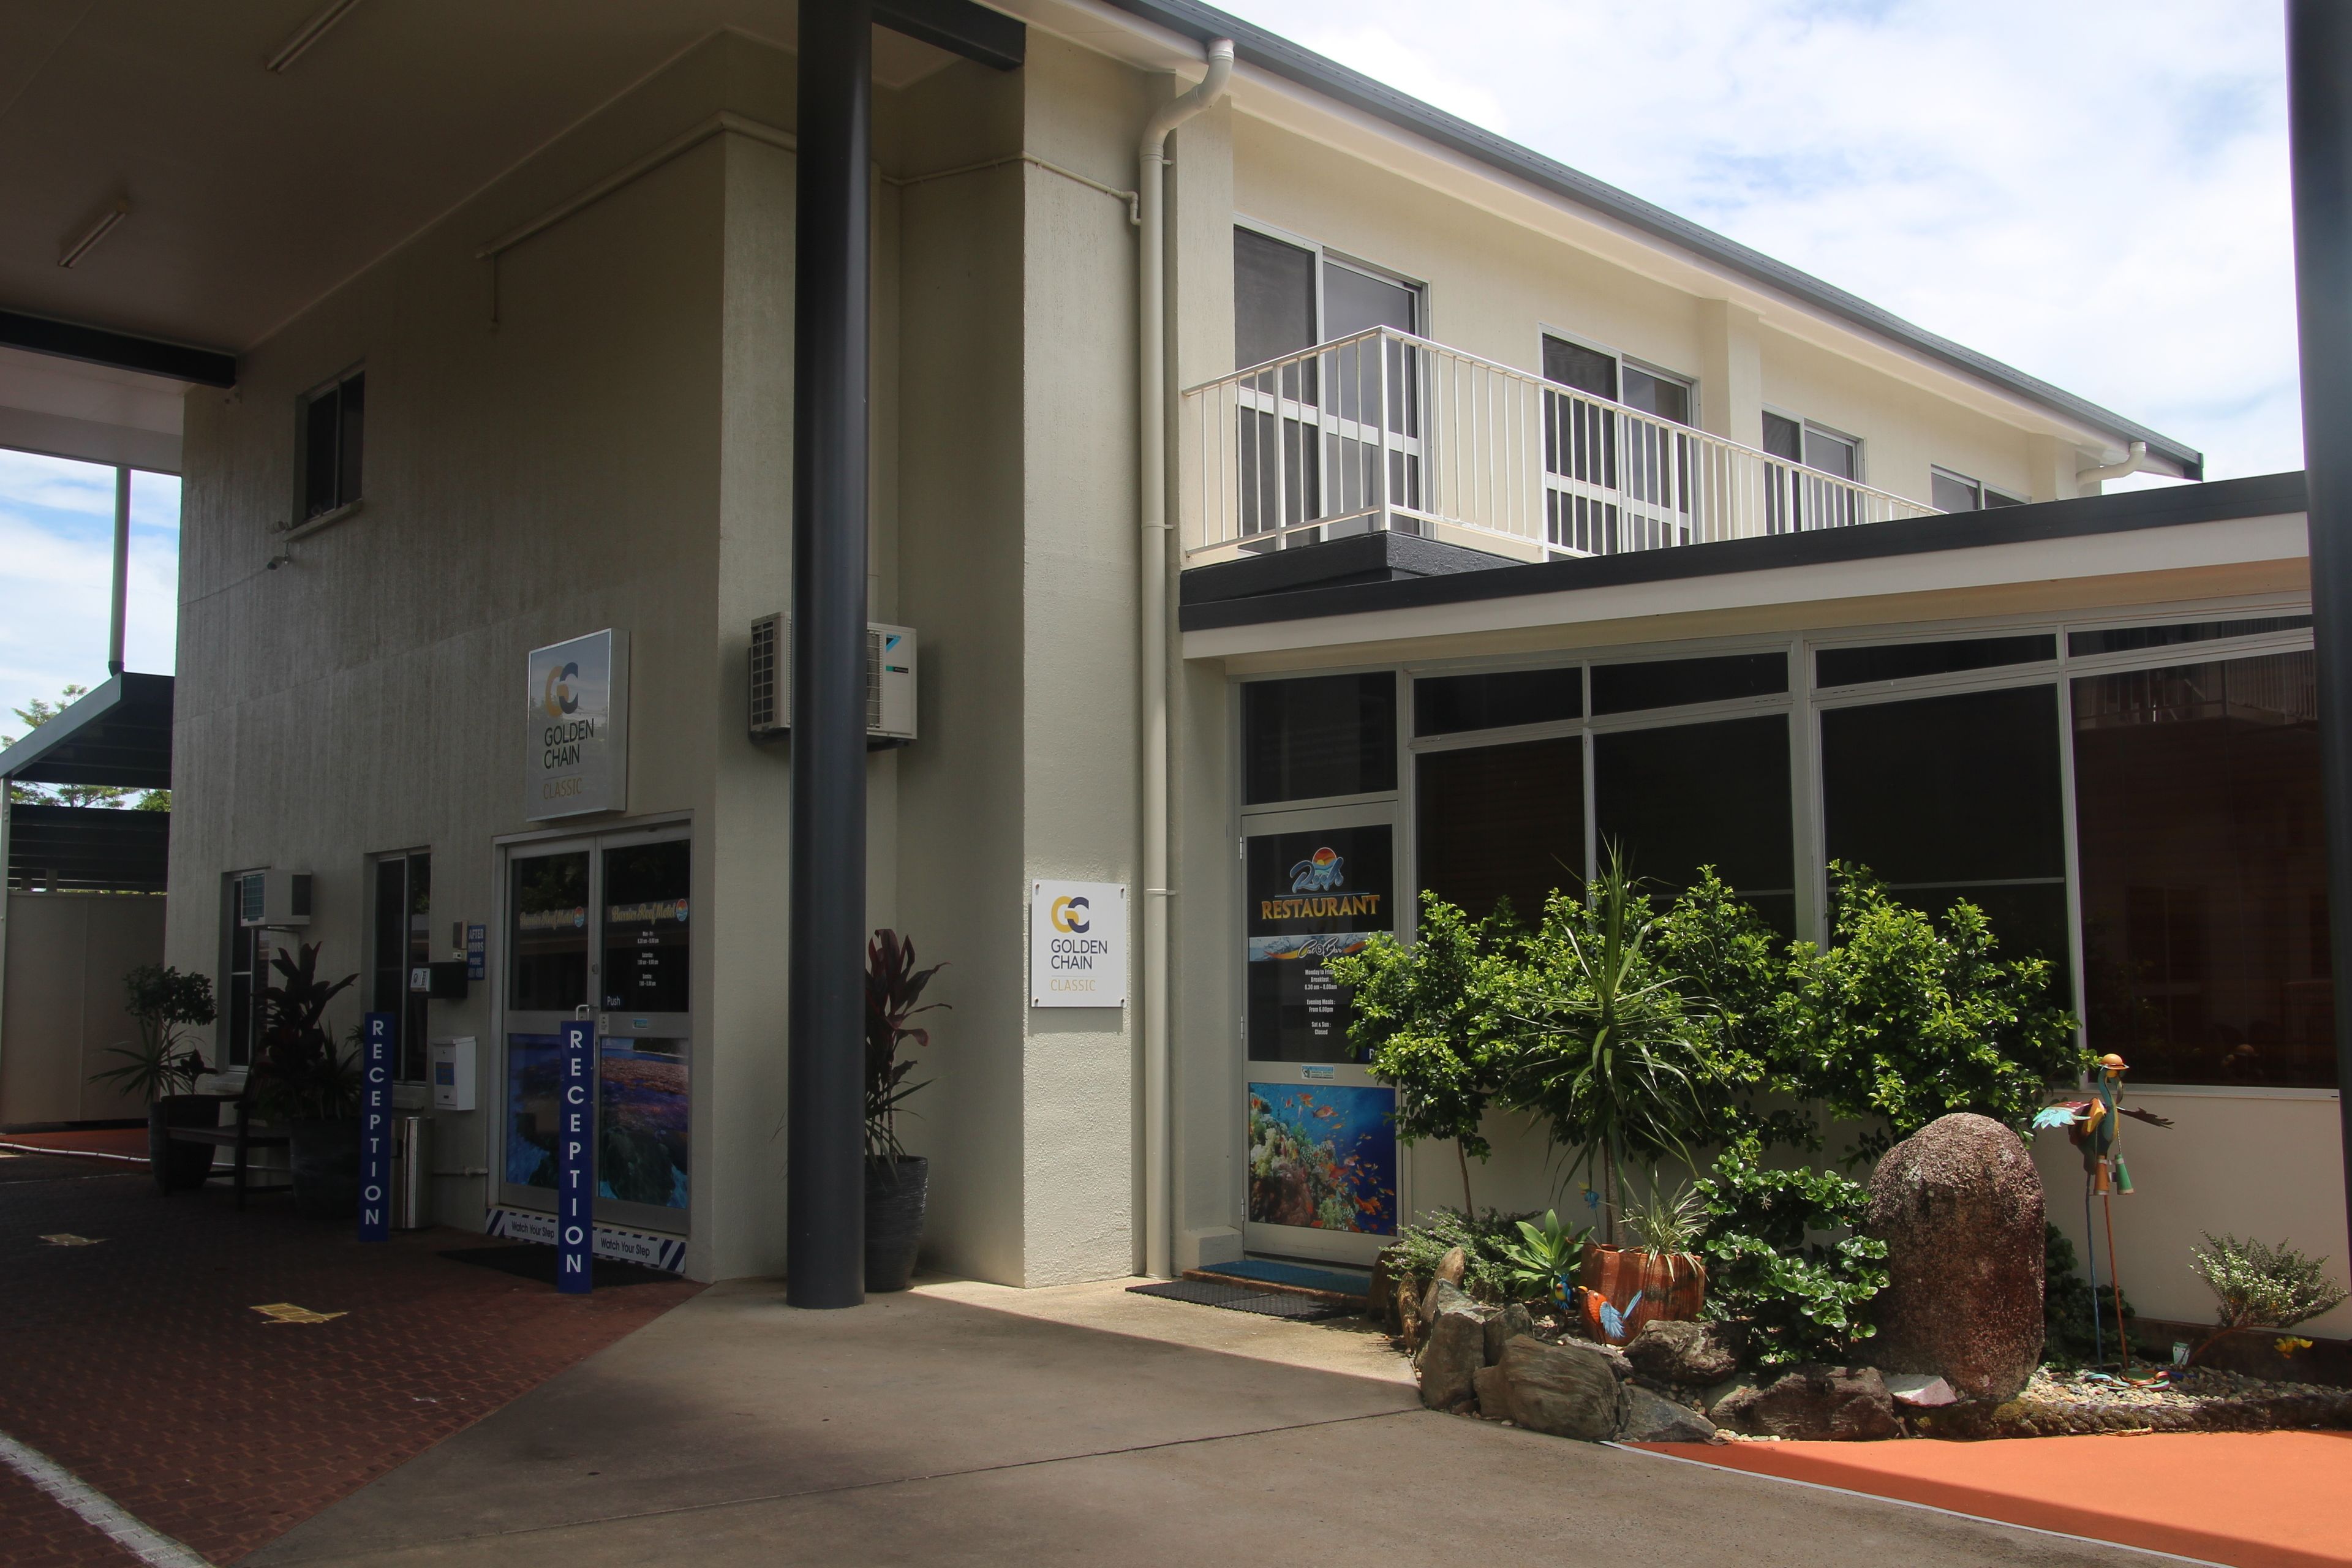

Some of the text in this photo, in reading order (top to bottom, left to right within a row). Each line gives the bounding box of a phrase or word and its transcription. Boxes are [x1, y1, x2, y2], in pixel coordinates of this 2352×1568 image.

[545, 718, 594, 747] GOLDEN
[544, 744, 580, 769] CHAIN
[543, 777, 582, 799] CLASSIC
[1262, 894, 1380, 919] RESTAURANT
[469, 929, 483, 939] AFTER
[468, 941, 483, 952] HOURS
[1051, 939, 1107, 954] GOLDEN
[1298, 939, 1316, 959] Cat
[1322, 937, 1343, 957] Bar
[1051, 955, 1092, 970] CHAIN
[1050, 979, 1096, 991] CLASSIC
[607, 996, 620, 1006] Push
[365, 1020, 385, 1225] RECEPTION
[565, 1030, 584, 1273] RECEPTION
[511, 1220, 554, 1240] Watch Your Step
[601, 1237, 650, 1259] Watch Your Step
